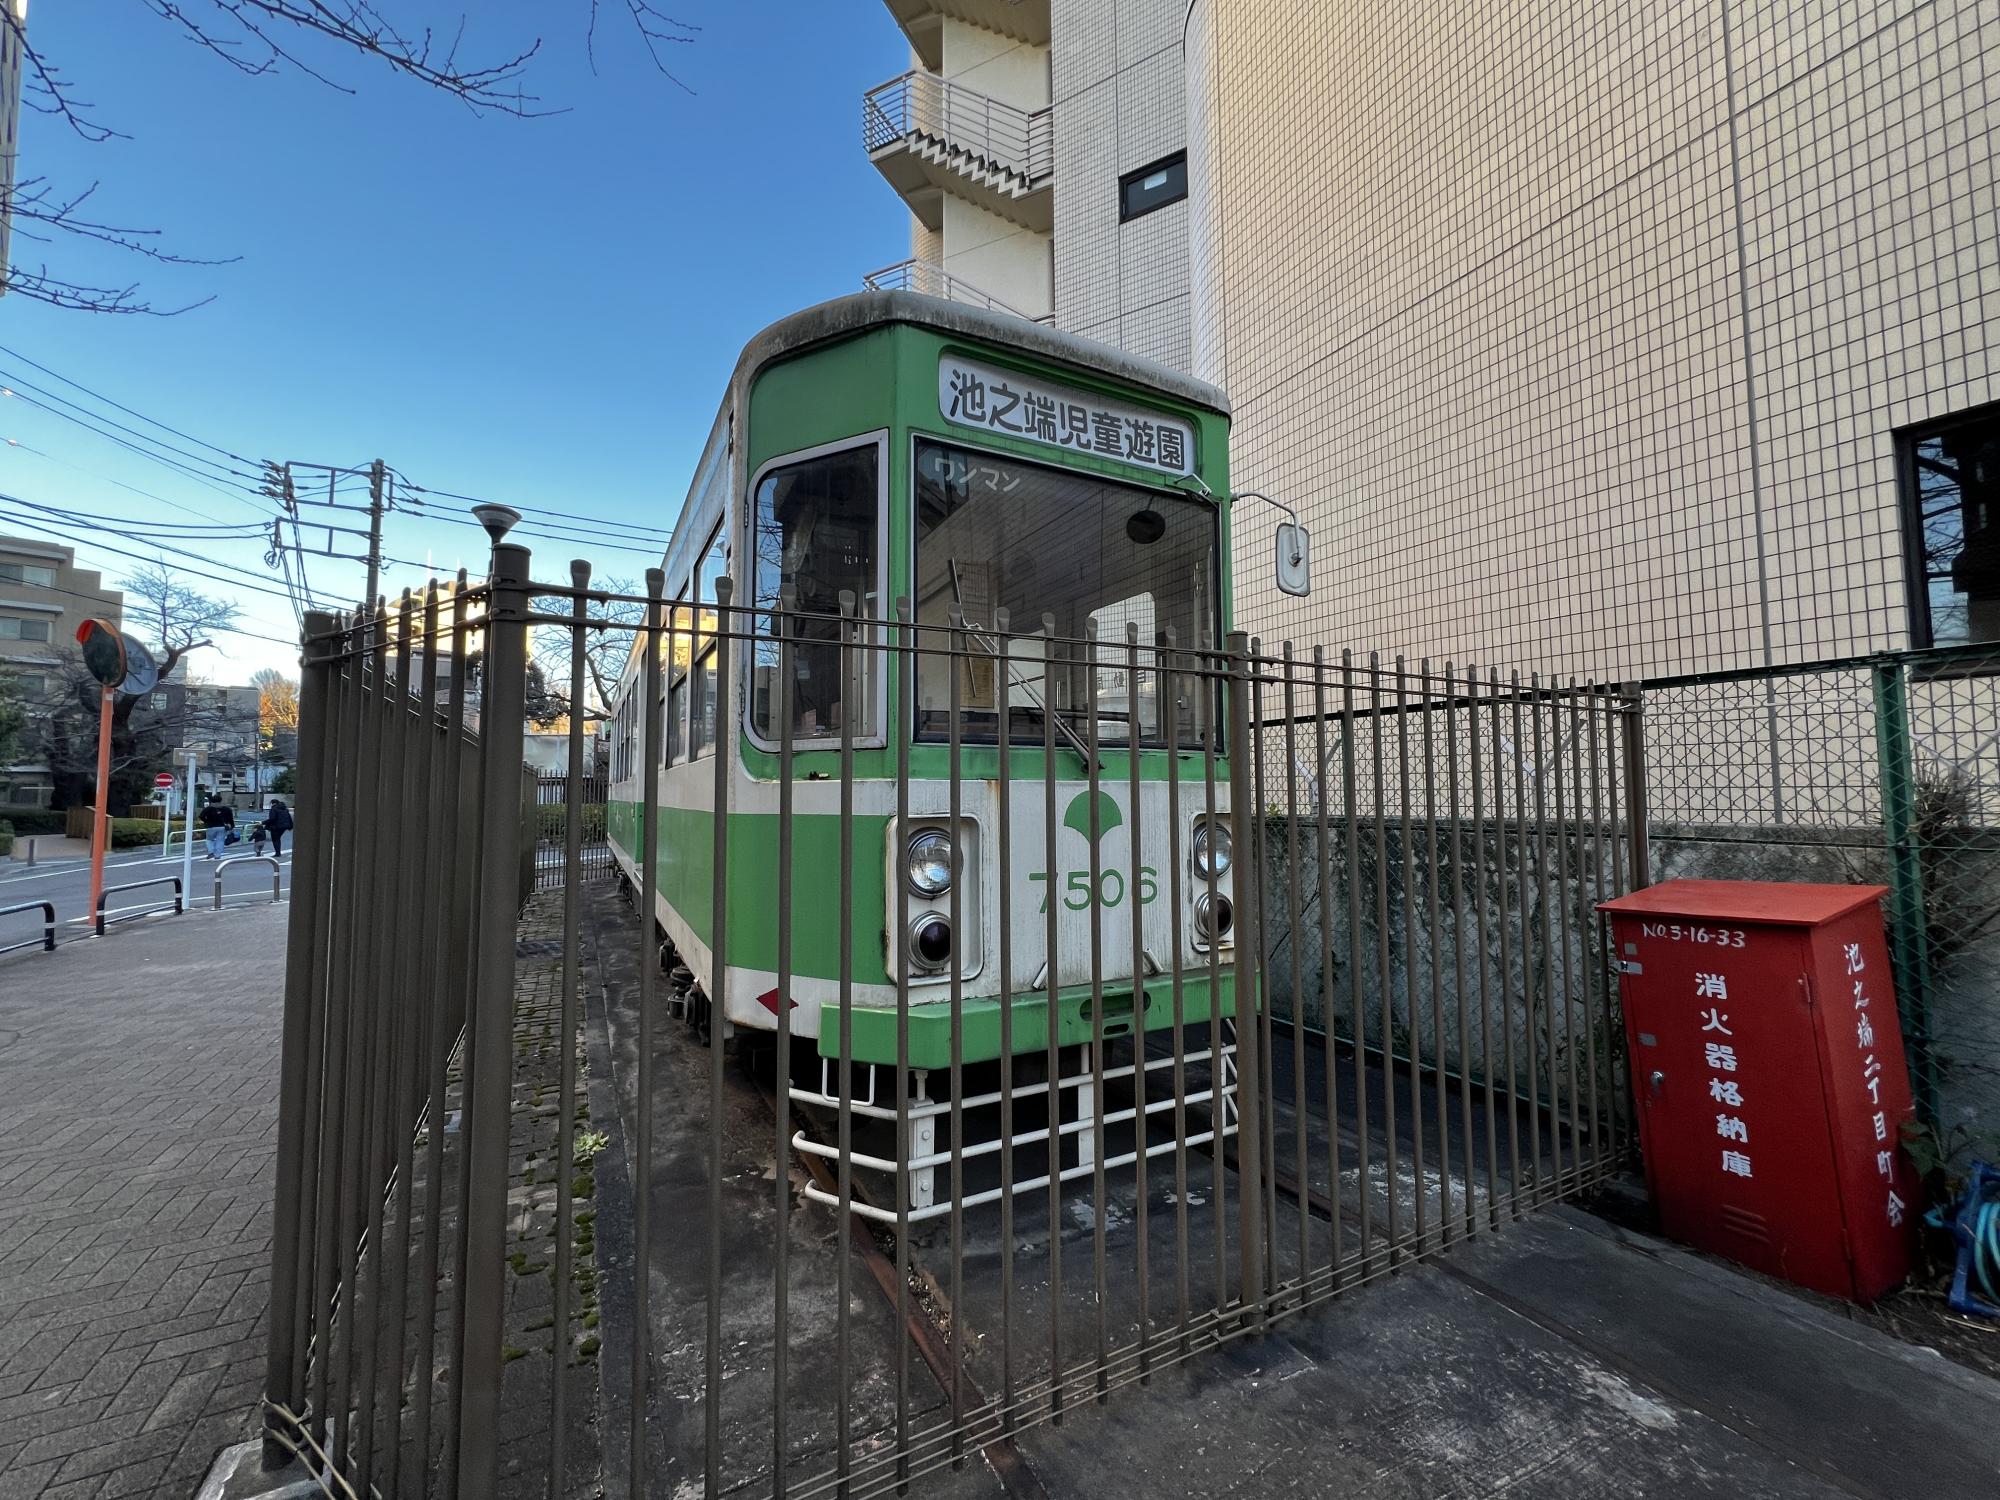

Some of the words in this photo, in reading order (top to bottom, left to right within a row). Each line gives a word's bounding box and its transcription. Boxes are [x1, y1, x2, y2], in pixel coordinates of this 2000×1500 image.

[949, 368, 1185, 471] 池之端児童遊園
[934, 457, 1020, 492] ワンマン
[1028, 865, 1158, 914] 7506
[1695, 972, 1753, 1178] 消火器格納庫
[1844, 943, 1905, 1228] 池之端二丁目町会
